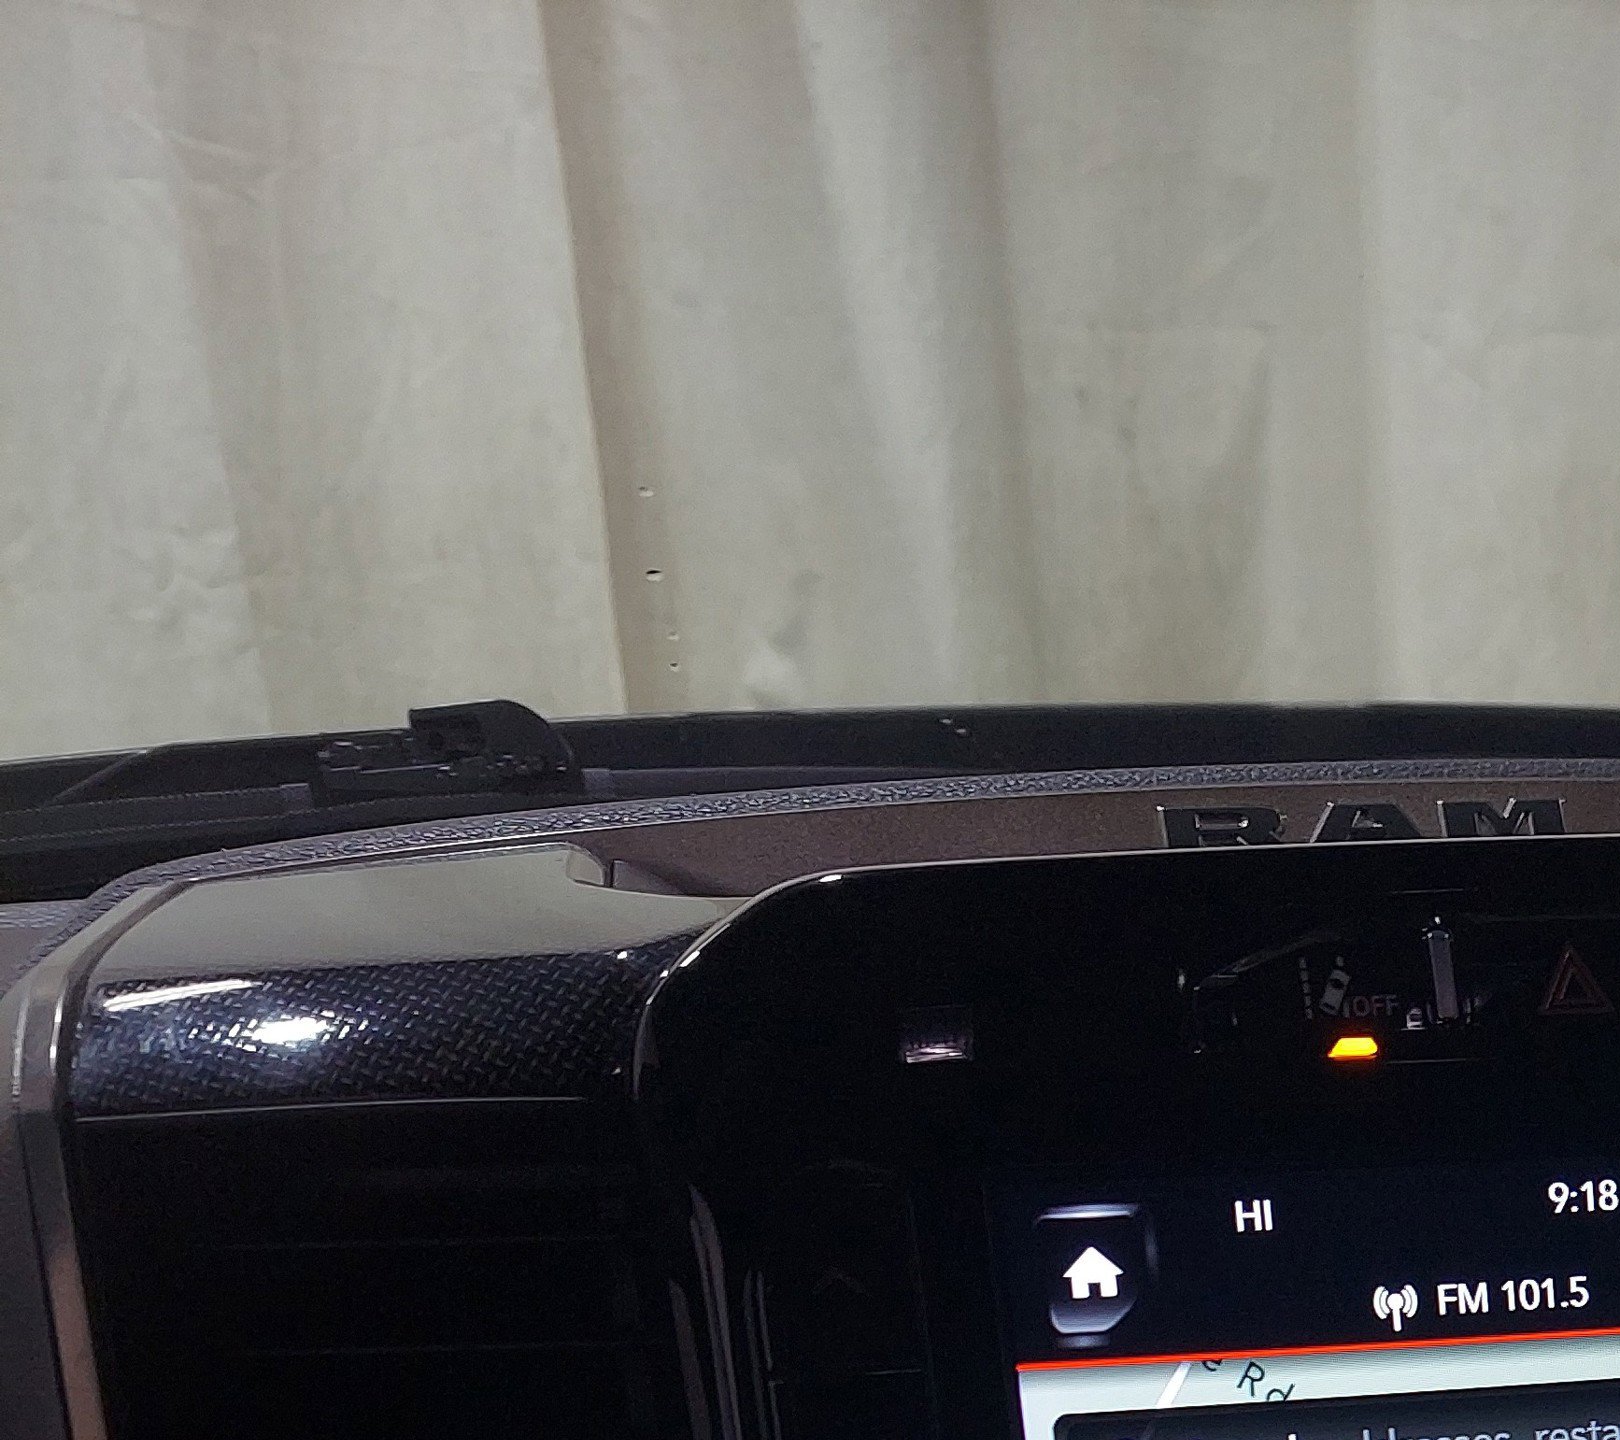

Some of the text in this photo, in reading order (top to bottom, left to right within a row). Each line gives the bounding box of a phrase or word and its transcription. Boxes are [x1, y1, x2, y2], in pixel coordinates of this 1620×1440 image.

[1157, 798, 1566, 848] RAM
[1352, 993, 1399, 1017] OFF
[1547, 1179, 1620, 1215] 9:18
[1234, 1199, 1274, 1233] HI
[1436, 1276, 1590, 1316] FM 101.5
